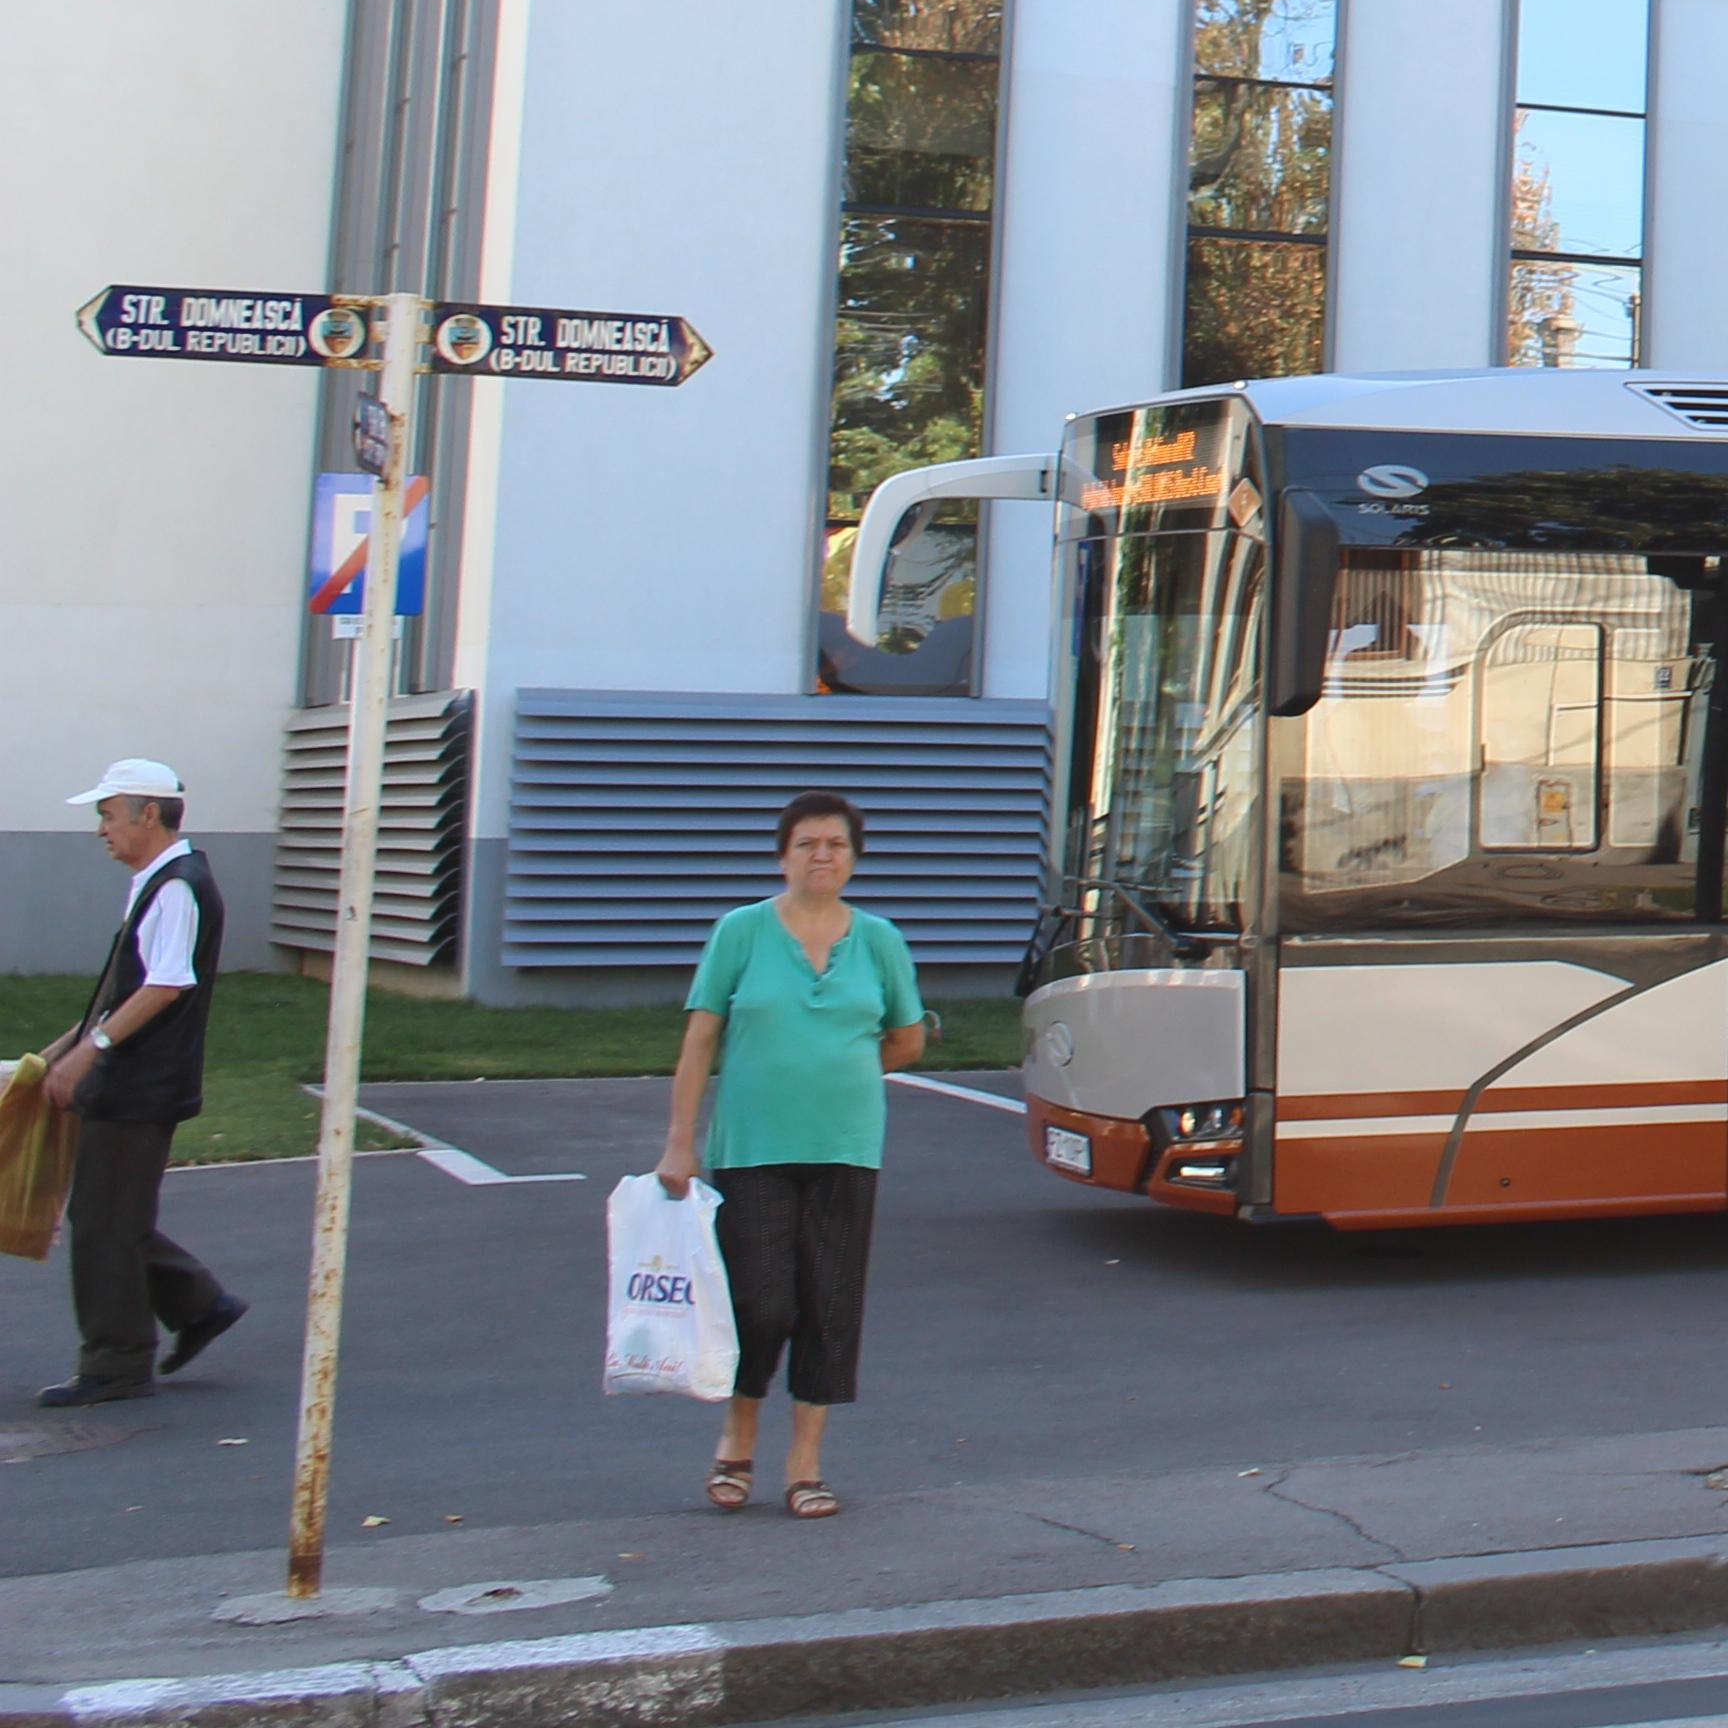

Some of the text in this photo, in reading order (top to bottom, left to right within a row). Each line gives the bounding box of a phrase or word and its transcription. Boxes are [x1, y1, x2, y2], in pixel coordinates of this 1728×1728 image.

[120, 294, 170, 325] STR.
[105, 328, 307, 358] (B-DUL REPUBLICII)
[501, 315, 547, 346] STR.
[489, 347, 678, 381] (B-DUL REPUBLICII)
[1357, 503, 1432, 515] SOLARIS
